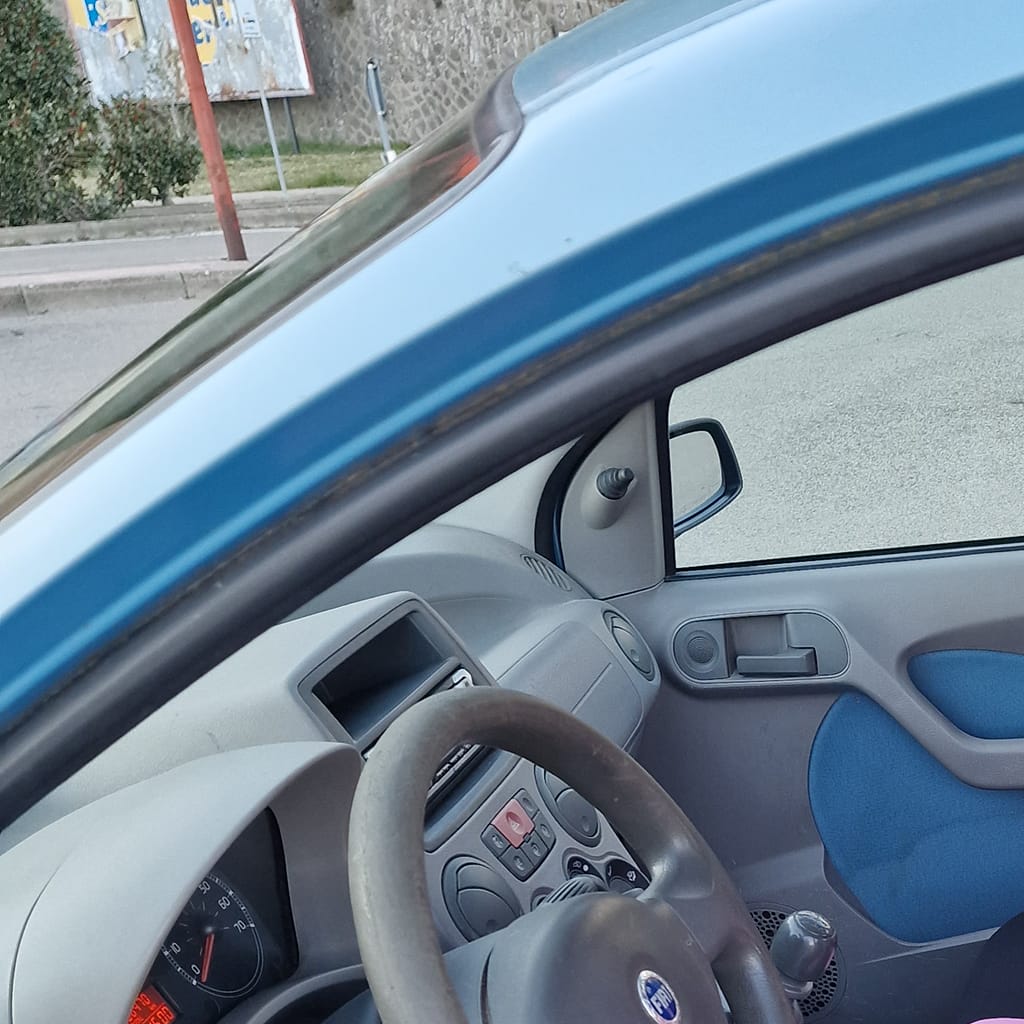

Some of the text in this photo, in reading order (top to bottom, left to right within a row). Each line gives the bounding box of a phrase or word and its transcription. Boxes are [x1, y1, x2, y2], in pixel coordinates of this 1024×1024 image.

[218, 896, 231, 910] 60
[233, 920, 247, 933] 70
[191, 964, 201, 975] 0
